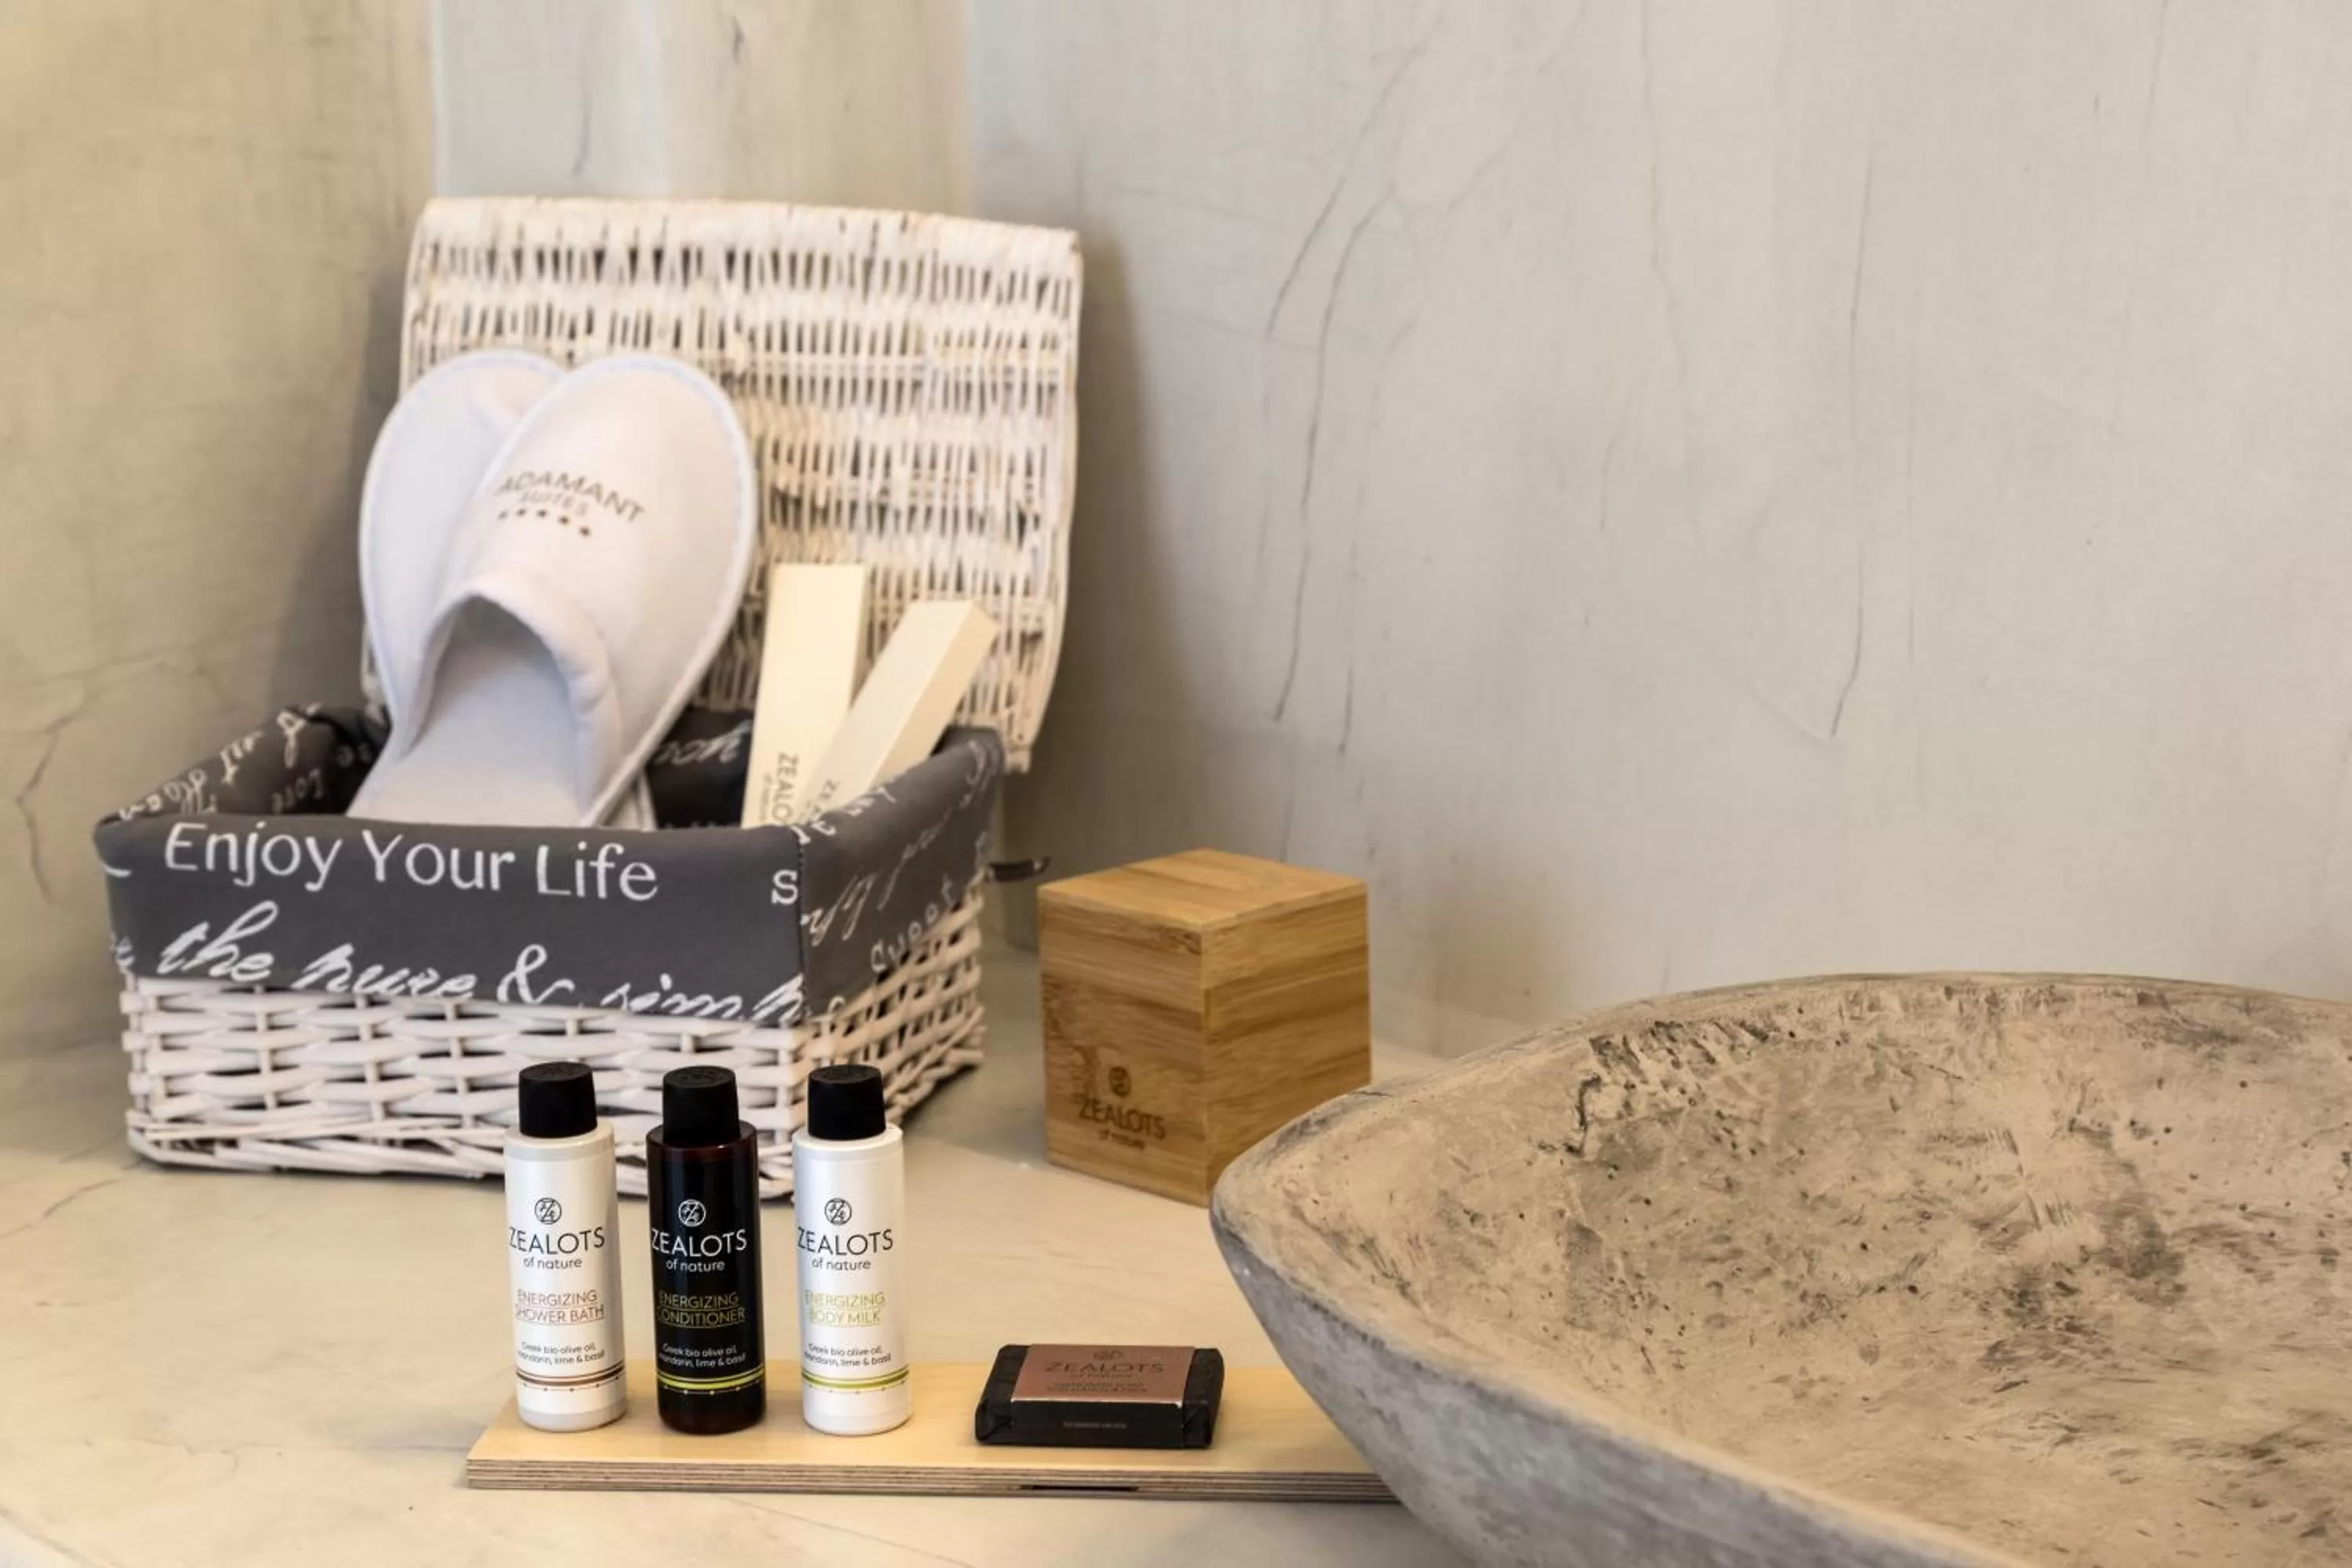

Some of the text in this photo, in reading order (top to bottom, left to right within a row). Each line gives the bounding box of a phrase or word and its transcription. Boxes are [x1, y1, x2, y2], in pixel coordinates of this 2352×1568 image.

[165, 822, 659, 902] Enjoy Your Life
[158, 900, 279, 982] the
[1079, 1097, 1167, 1141] ZEALOTS
[510, 1227, 604, 1255] ZEALOTS
[652, 1229, 747, 1257] ZEALOTS
[797, 1226, 894, 1256] ZEALOTS
[524, 1257, 583, 1270] of nature
[666, 1259, 725, 1272] of nature
[811, 1258, 871, 1271] of nature
[517, 1289, 597, 1306] ENERGIZING
[659, 1290, 739, 1308] ENERGIZING
[804, 1290, 885, 1308] ENERGIZING
[570, 1305, 604, 1323] BATH
[848, 1308, 881, 1324] MILK
[1044, 1361, 1167, 1374] ZEALOTS
